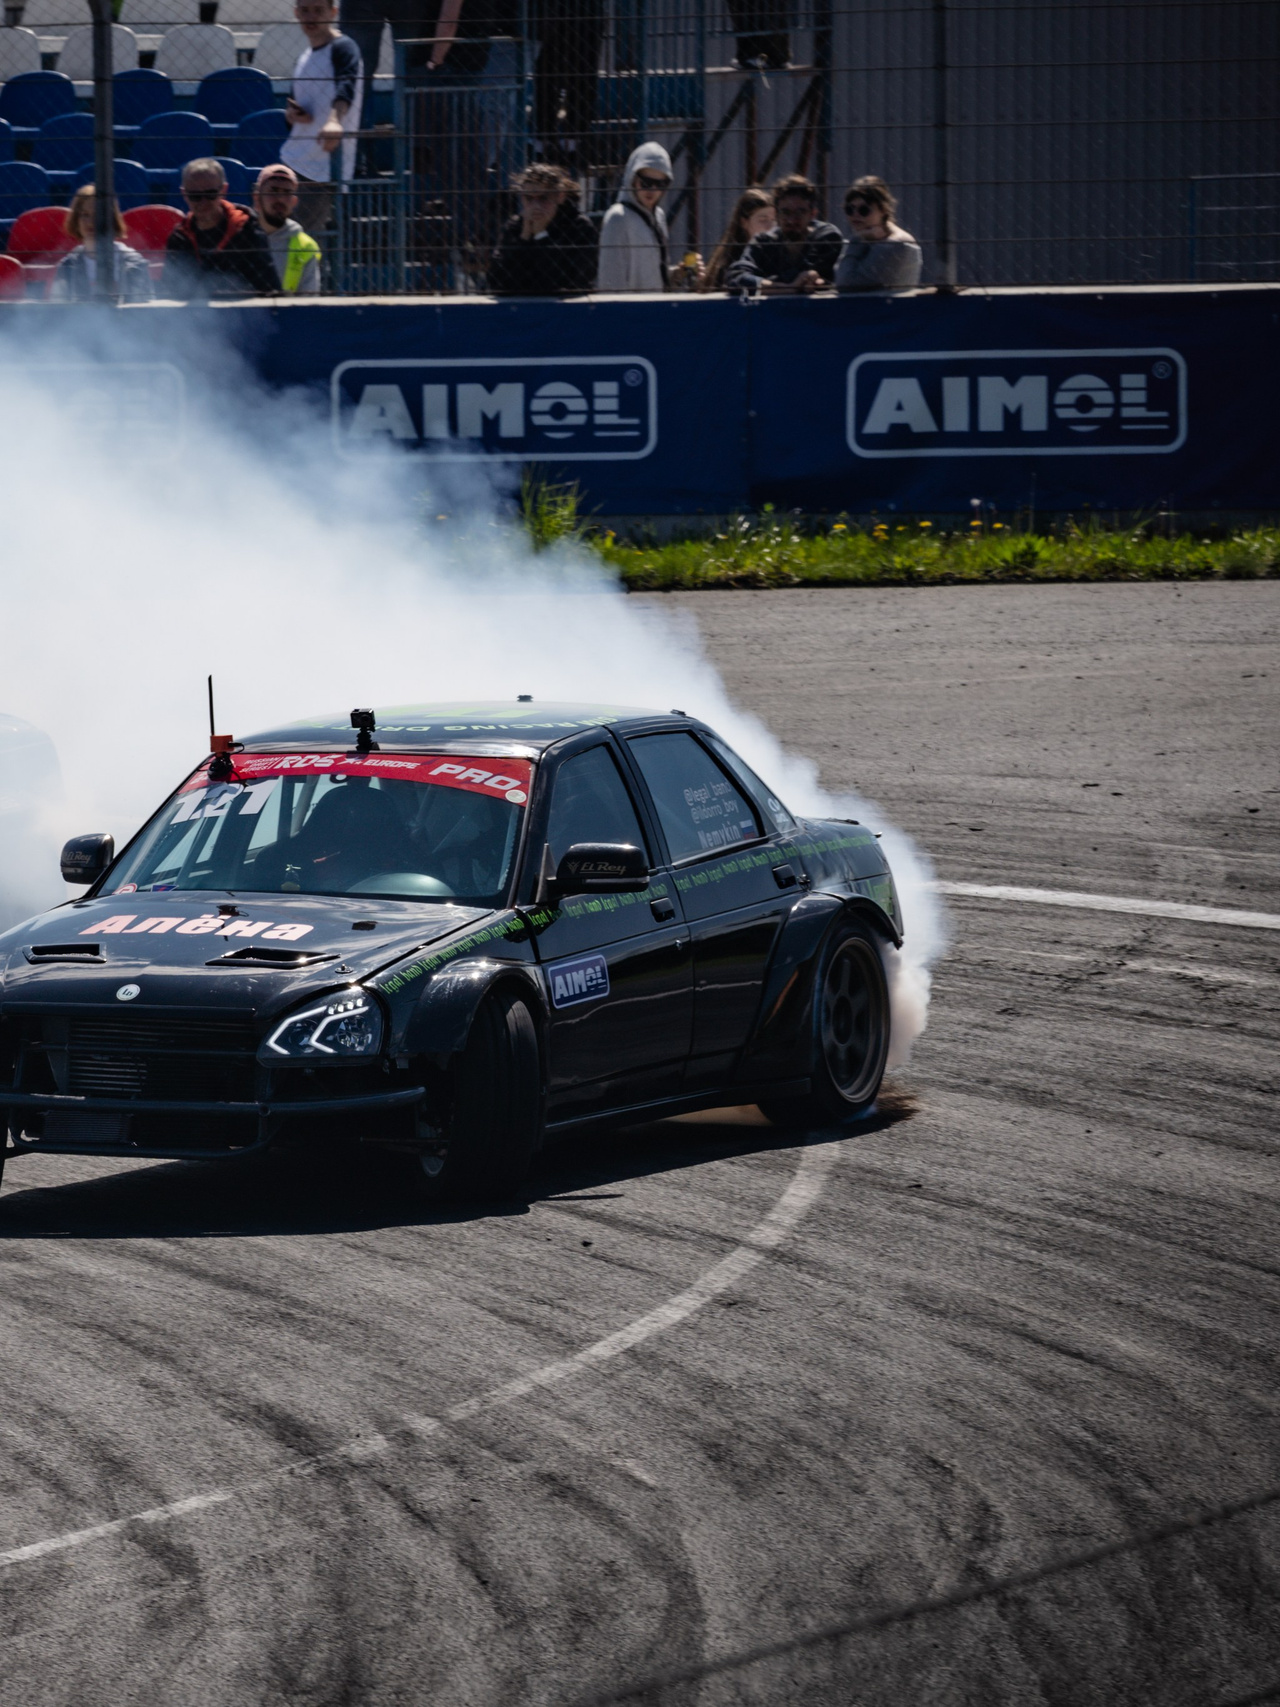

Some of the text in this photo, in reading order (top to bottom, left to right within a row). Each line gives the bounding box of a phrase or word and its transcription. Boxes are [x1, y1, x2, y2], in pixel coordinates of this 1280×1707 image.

[861, 374, 1169, 434] AIMOL
[274, 754, 522, 791] RDS EUROPE PRO
[170, 778, 279, 825] 121
[697, 821, 741, 849] Nemykin
[596, 861, 627, 876] Rey
[78, 914, 314, 941] Алёна
[555, 965, 607, 1000] AIMOL
